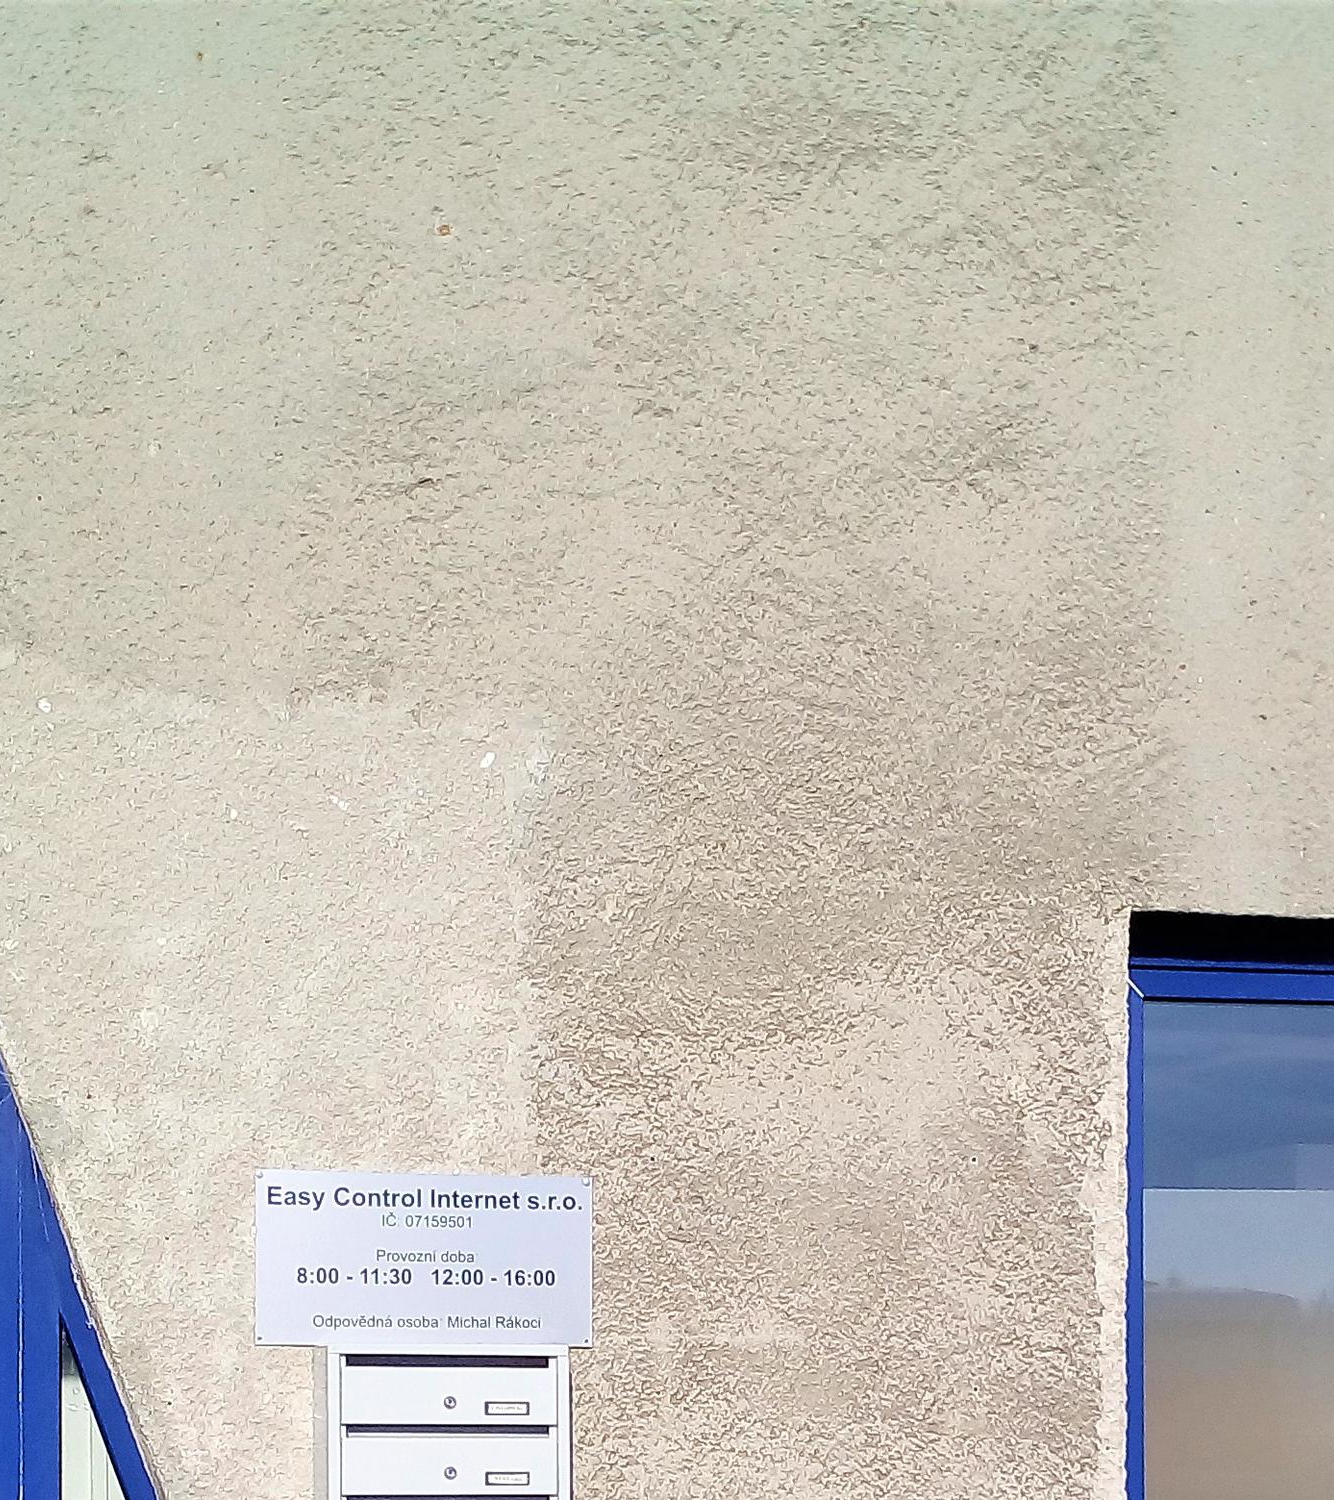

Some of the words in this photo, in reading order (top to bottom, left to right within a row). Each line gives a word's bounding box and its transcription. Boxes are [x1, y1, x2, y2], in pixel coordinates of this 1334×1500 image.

[267, 1185, 326, 1211] Easy
[334, 1186, 422, 1208] Control
[430, 1189, 520, 1210] Internet
[527, 1194, 584, 1211] s.r.o.
[405, 1215, 473, 1229] 07159501
[376, 1249, 437, 1264] Provozní
[296, 1267, 339, 1285] 8:00
[360, 1268, 412, 1285] 11:30
[431, 1269, 484, 1286] 12:00
[503, 1270, 556, 1287] 16:00
[313, 1314, 392, 1330] Odpovědná
[448, 1316, 490, 1329] Michal
